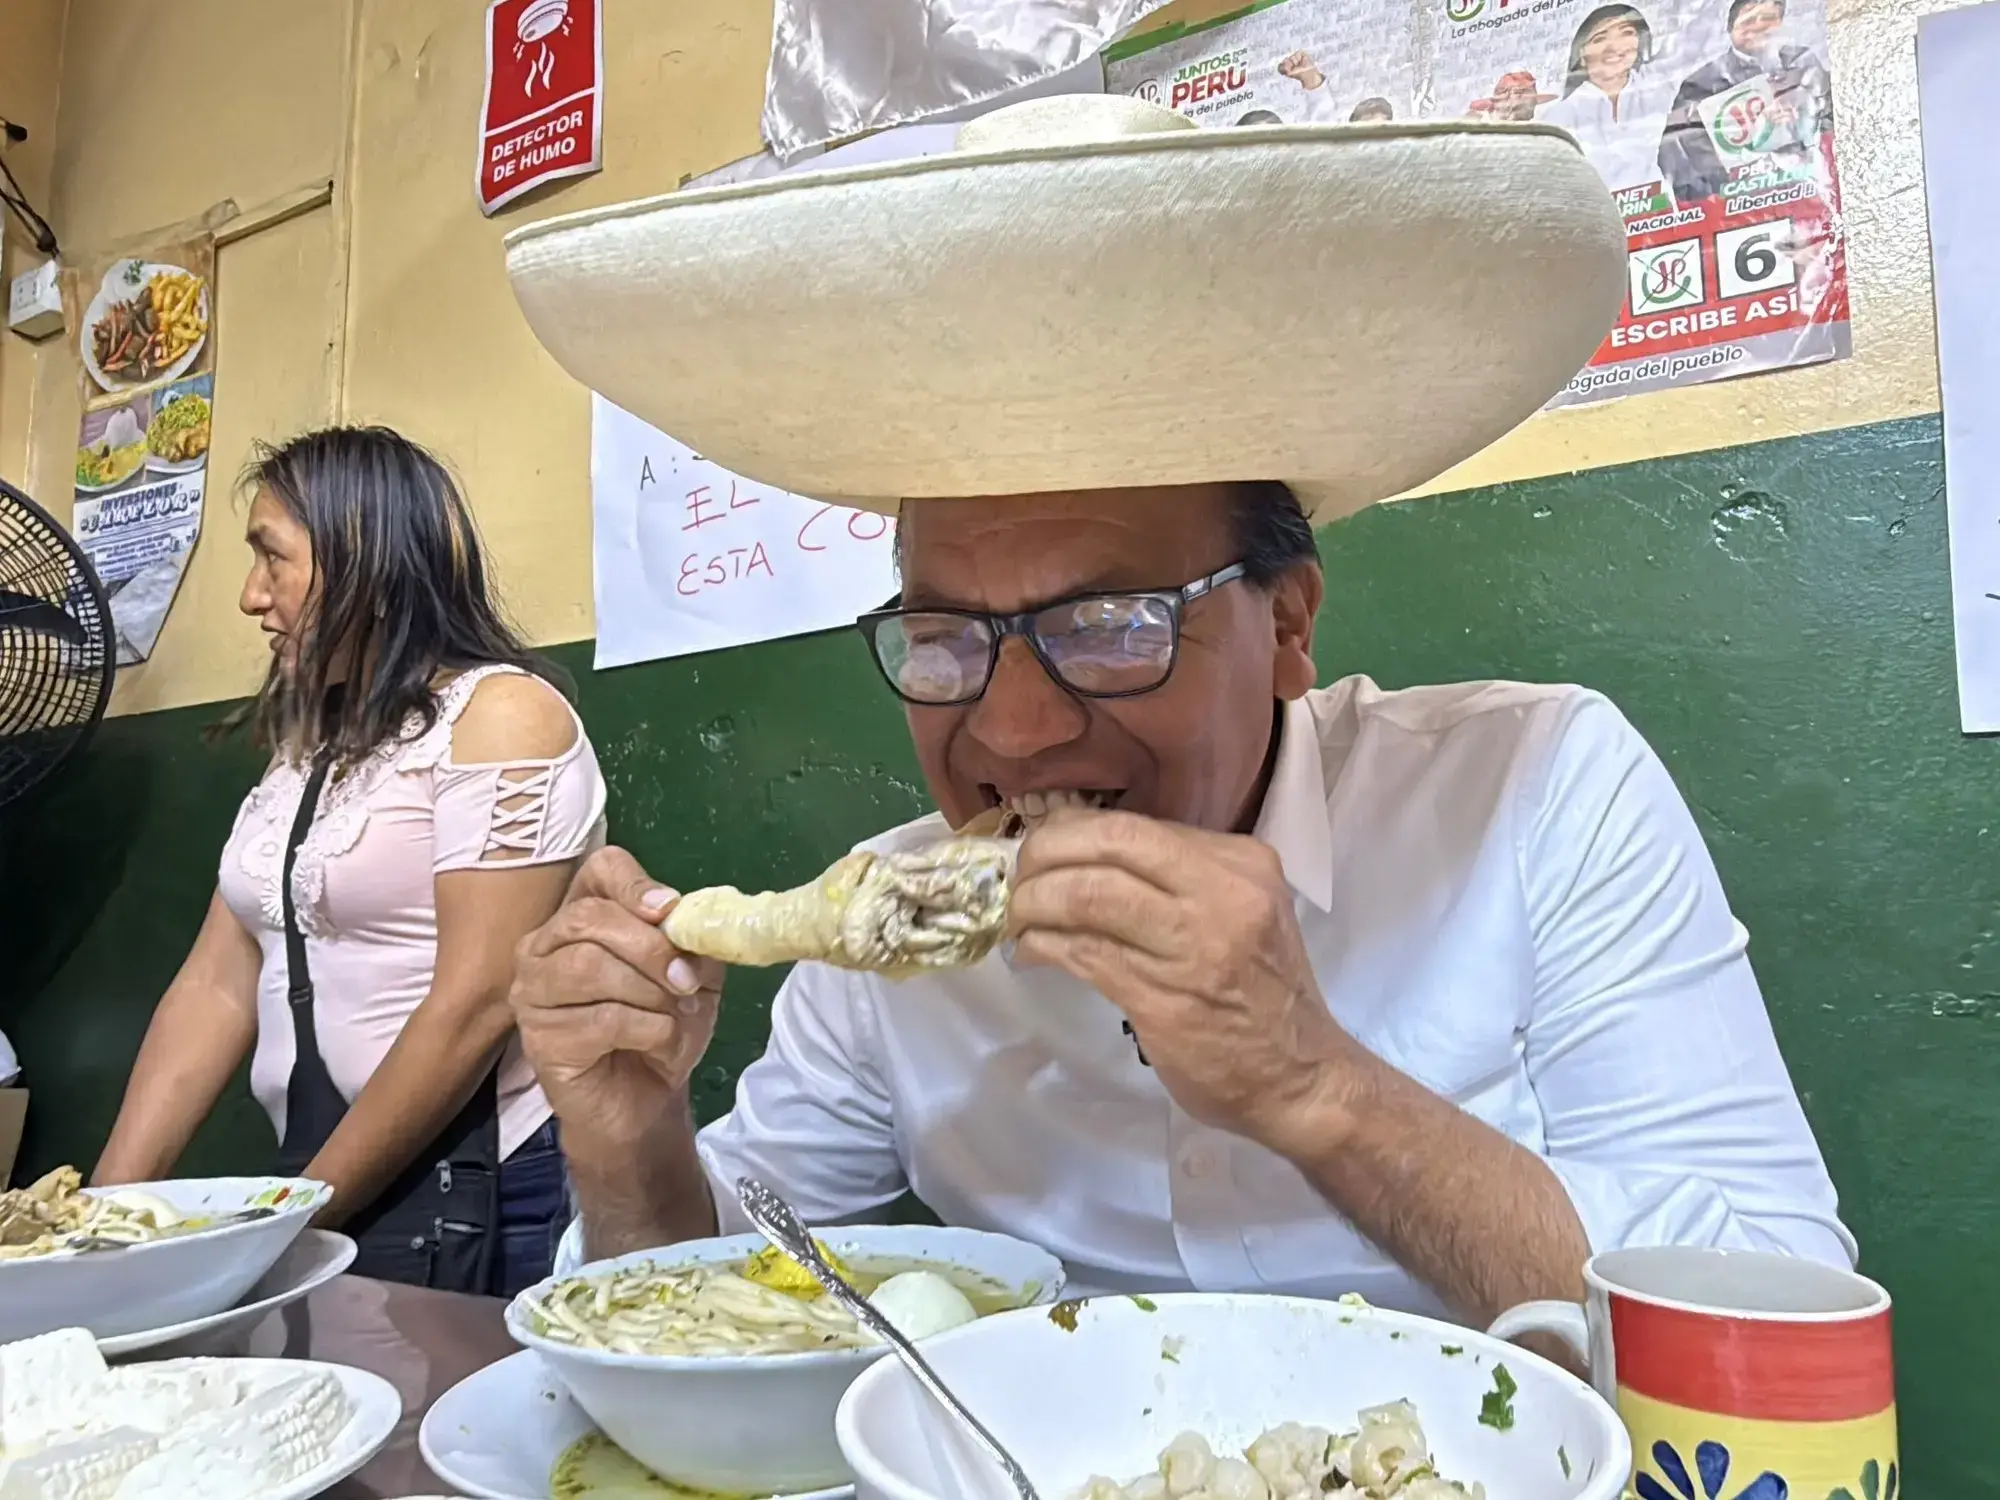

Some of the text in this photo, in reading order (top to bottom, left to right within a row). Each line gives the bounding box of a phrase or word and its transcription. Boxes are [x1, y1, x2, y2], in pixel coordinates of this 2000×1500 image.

[1451, 27, 1466, 39] La
[1468, 8, 1529, 34] abogada
[1532, 0, 1555, 14] del
[1171, 61, 1248, 109] PERÚ
[1174, 53, 1231, 82] JUNTOS
[1196, 103, 1214, 116] del
[1215, 91, 1254, 112] pueblo
[491, 110, 584, 162] DETECTOR
[493, 136, 576, 183] DE HUMO
[1629, 209, 1703, 233] NACIONAL
[1728, 184, 1801, 213] Libertad
[1735, 232, 1777, 282] 6
[1611, 286, 1799, 348] ESCRIBE ASÍ
[1636, 360, 1667, 379] del
[1672, 346, 1743, 376] pueblo
[682, 479, 760, 531] EL
[677, 505, 898, 595] ESTA CO
